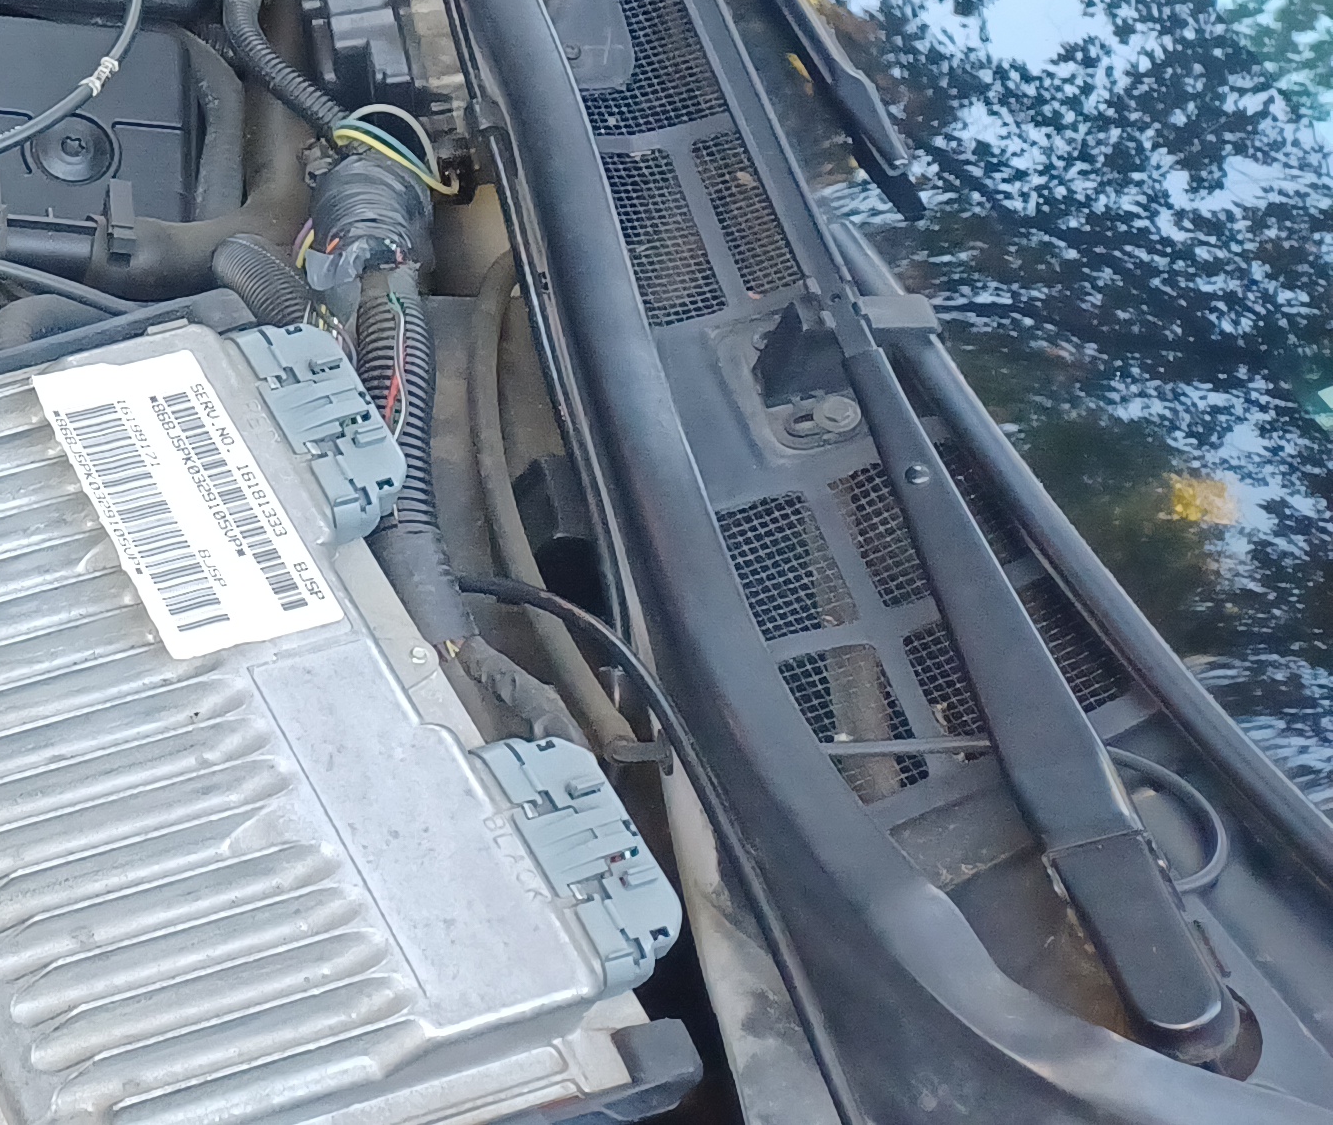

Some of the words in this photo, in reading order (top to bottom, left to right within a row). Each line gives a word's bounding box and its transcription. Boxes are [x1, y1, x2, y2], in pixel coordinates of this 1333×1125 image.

[114, 396, 160, 469] 16199171
[235, 460, 288, 539] 16181333
[480, 809, 550, 908] BLACK
